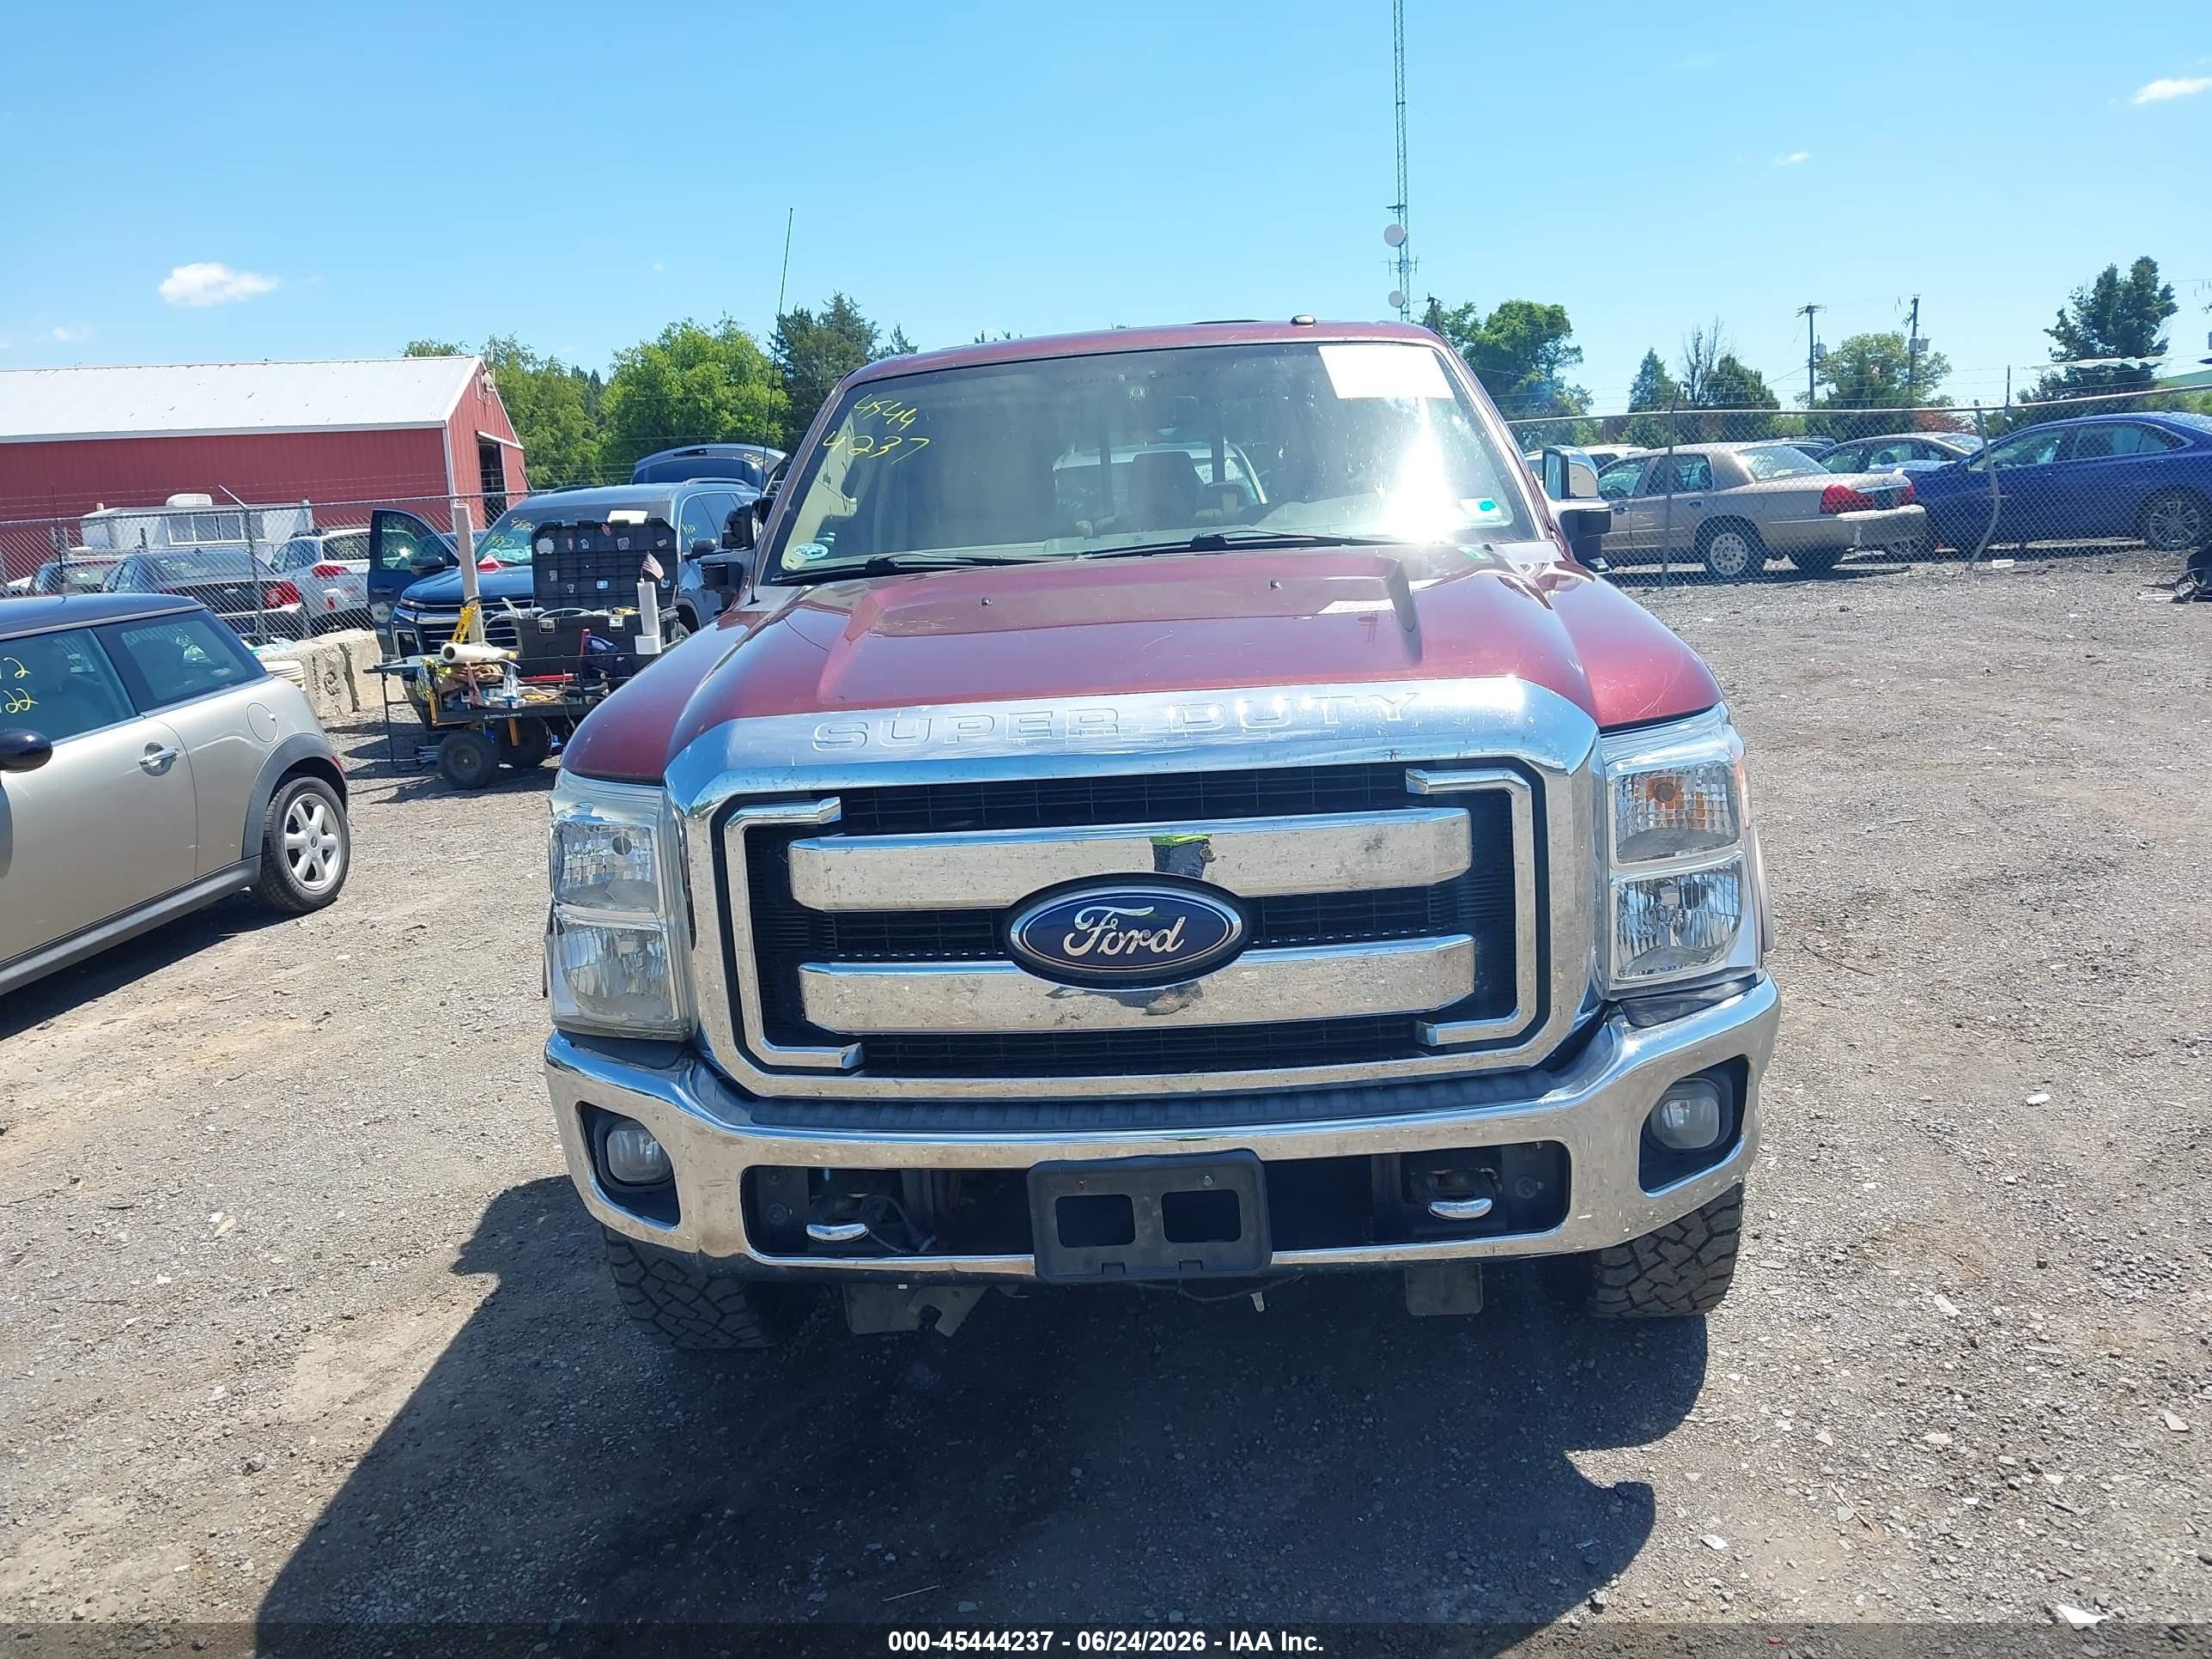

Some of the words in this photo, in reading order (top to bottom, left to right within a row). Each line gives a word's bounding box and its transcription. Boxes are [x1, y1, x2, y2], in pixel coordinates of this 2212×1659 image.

[854, 393, 917, 432] 4544
[823, 430, 930, 465] 4237
[812, 708, 1120, 751] SUPER
[1169, 692, 1420, 732] DUTY
[1063, 906, 1188, 957] Ford
